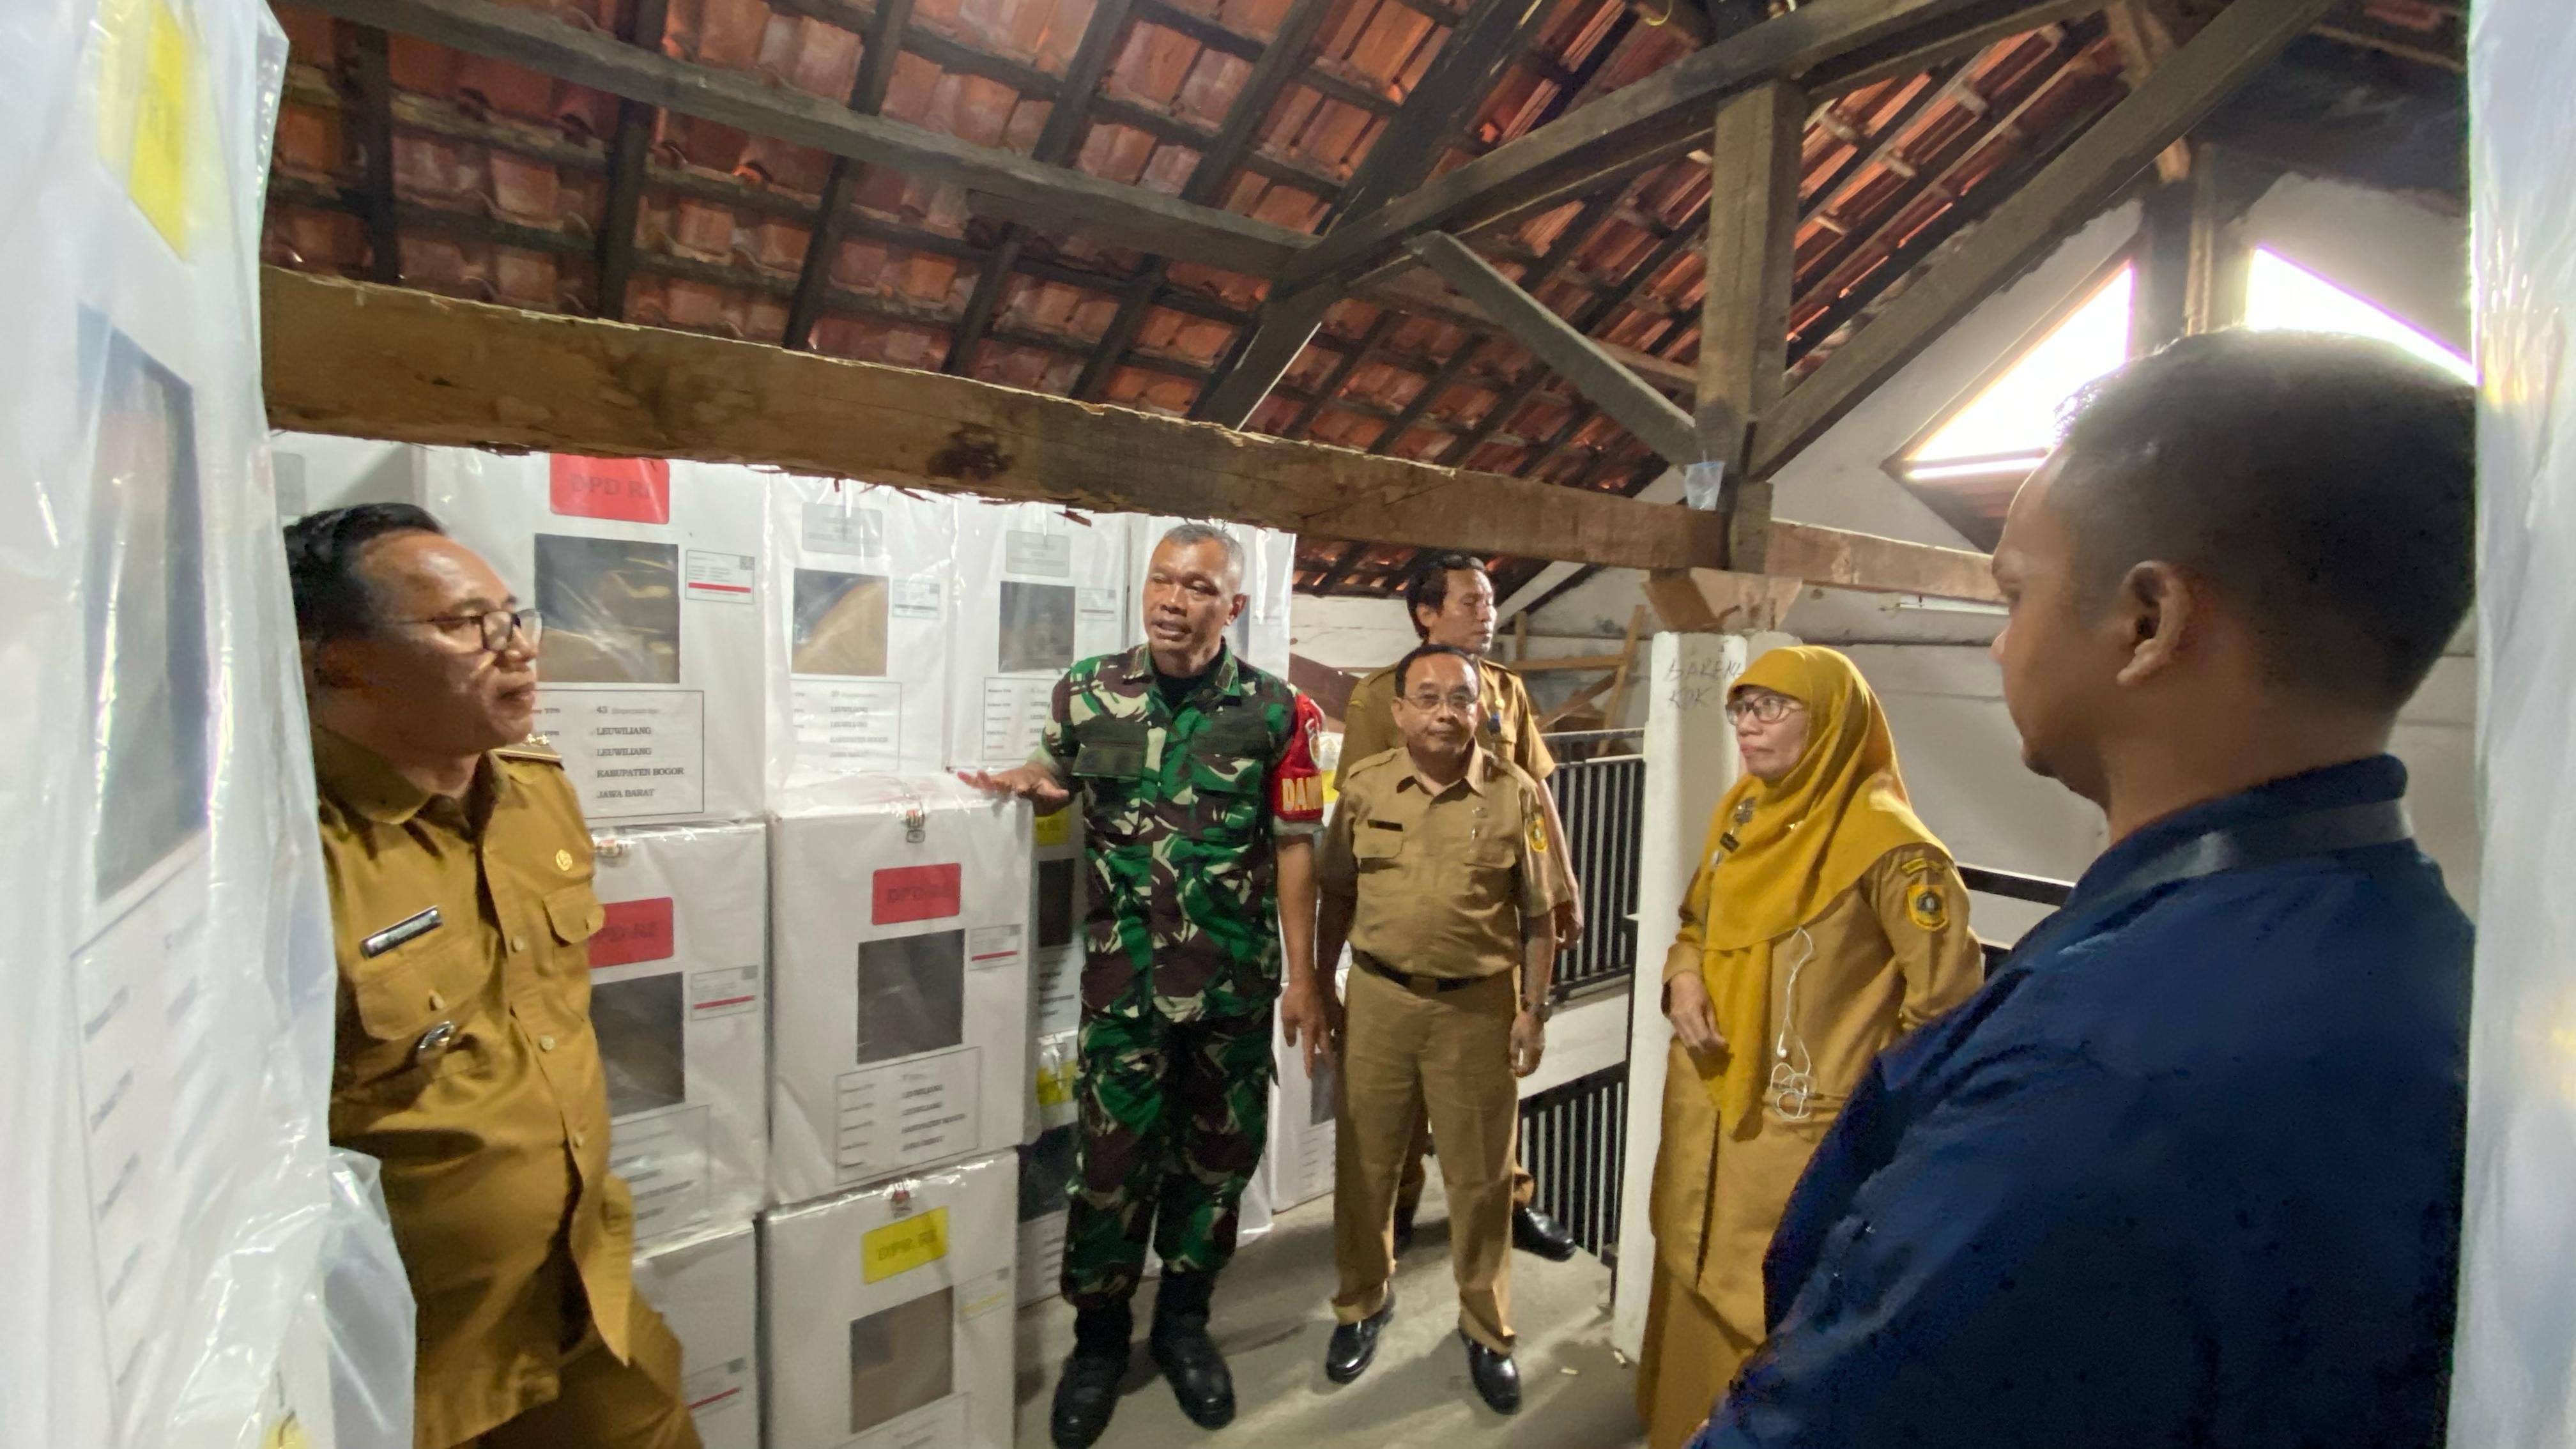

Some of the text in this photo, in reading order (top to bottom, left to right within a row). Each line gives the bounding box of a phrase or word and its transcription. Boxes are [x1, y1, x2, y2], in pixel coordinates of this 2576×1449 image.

[571, 473, 620, 495] DPD
[596, 727, 651, 735] LEUWILIANG
[597, 748, 652, 756] LEUWILIANG
[597, 767, 684, 778] KABUPATEN BOGOR
[596, 789, 655, 798] JAWA BARAT
